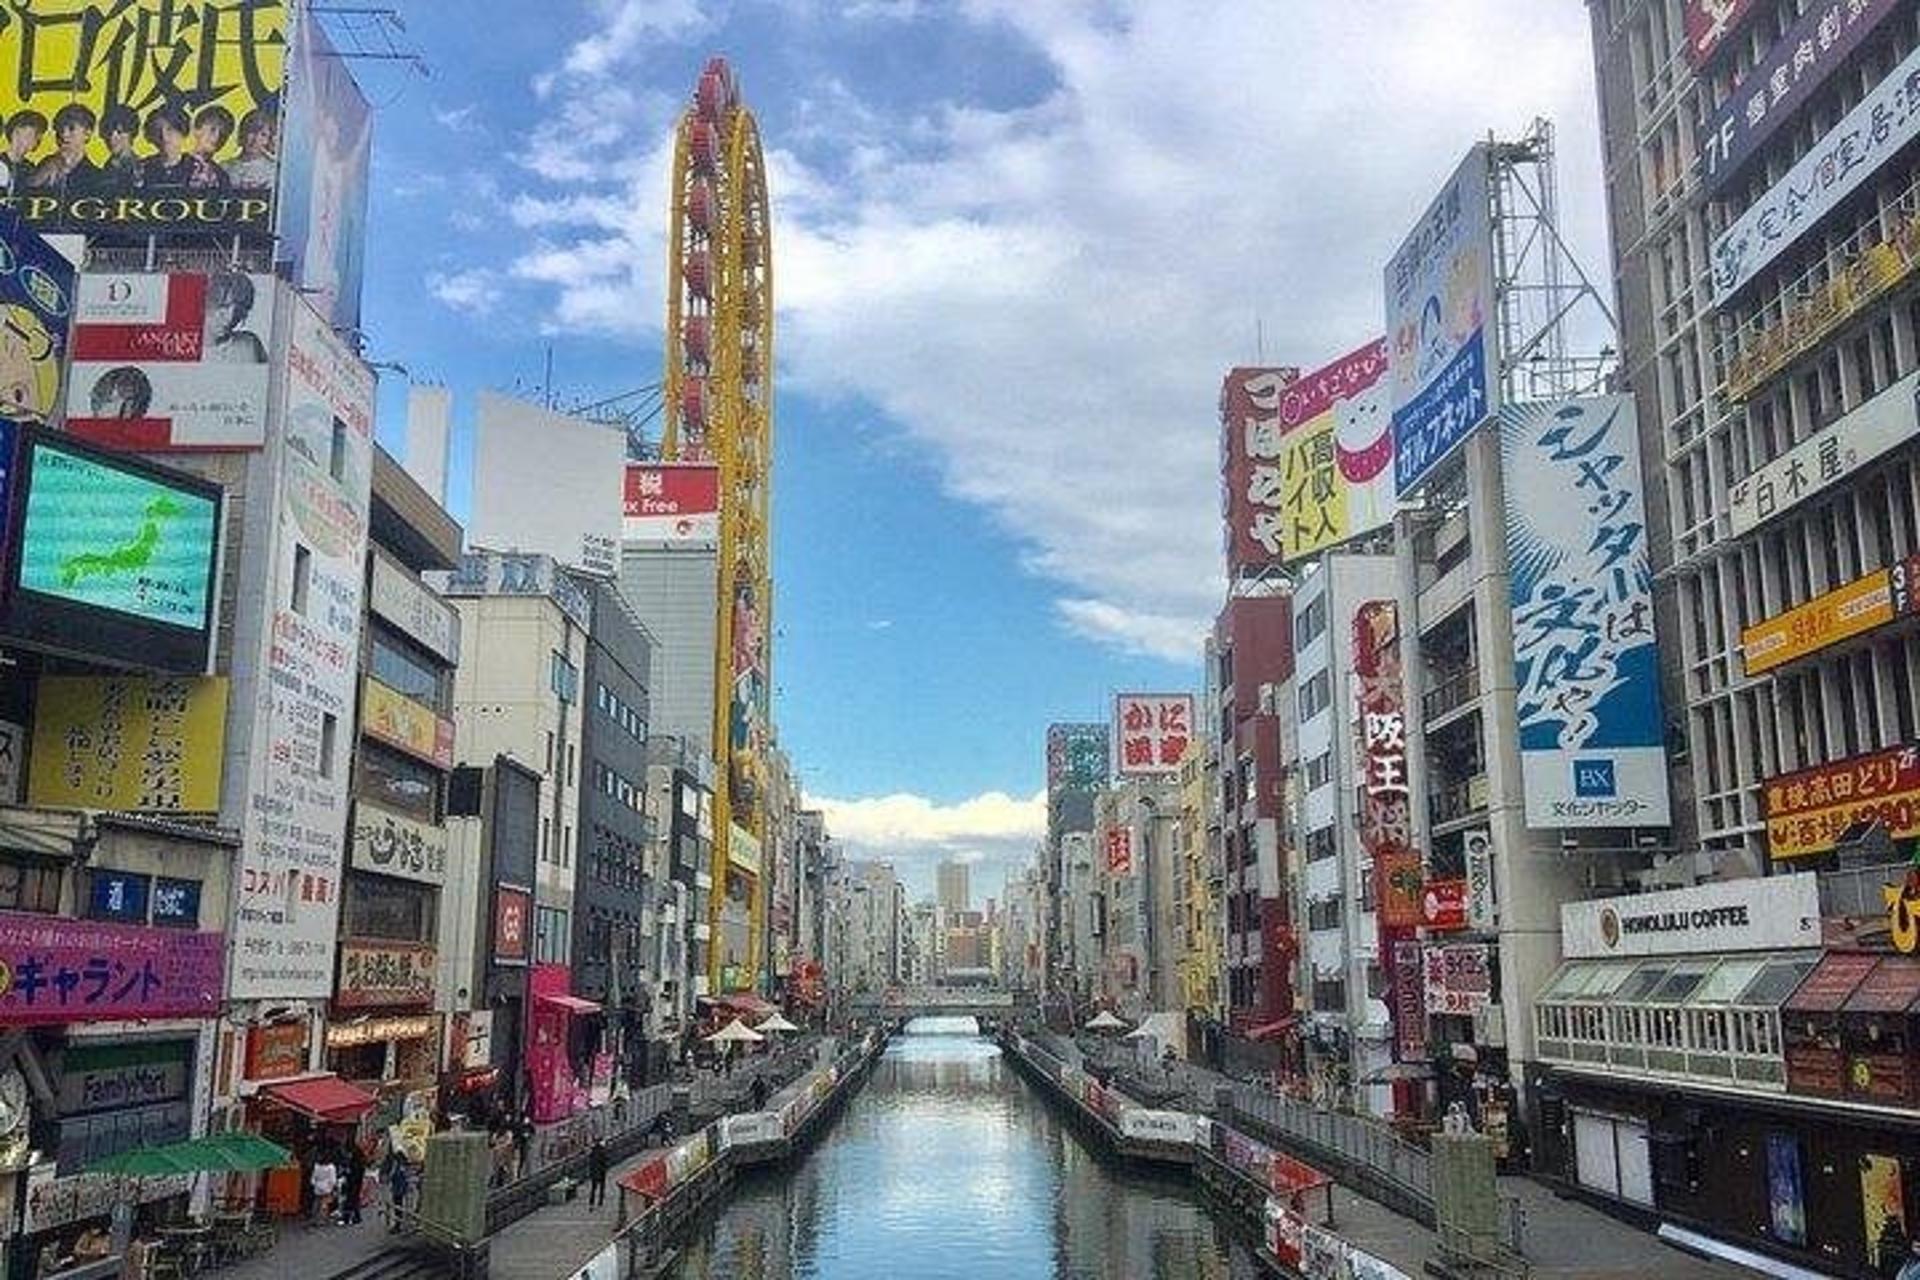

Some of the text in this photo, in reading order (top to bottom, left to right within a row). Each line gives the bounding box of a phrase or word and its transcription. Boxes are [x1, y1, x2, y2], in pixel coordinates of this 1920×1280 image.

[1705, 115, 1735, 175] 7F
[71, 198, 268, 222] GROUP
[1312, 427, 1337, 543] 高収入
[1756, 434, 1843, 519] 白木屋
[641, 497, 679, 514] Free
[1622, 905, 1749, 935] HONOLULU COFFEE
[15, 956, 162, 1005] ギャラント
